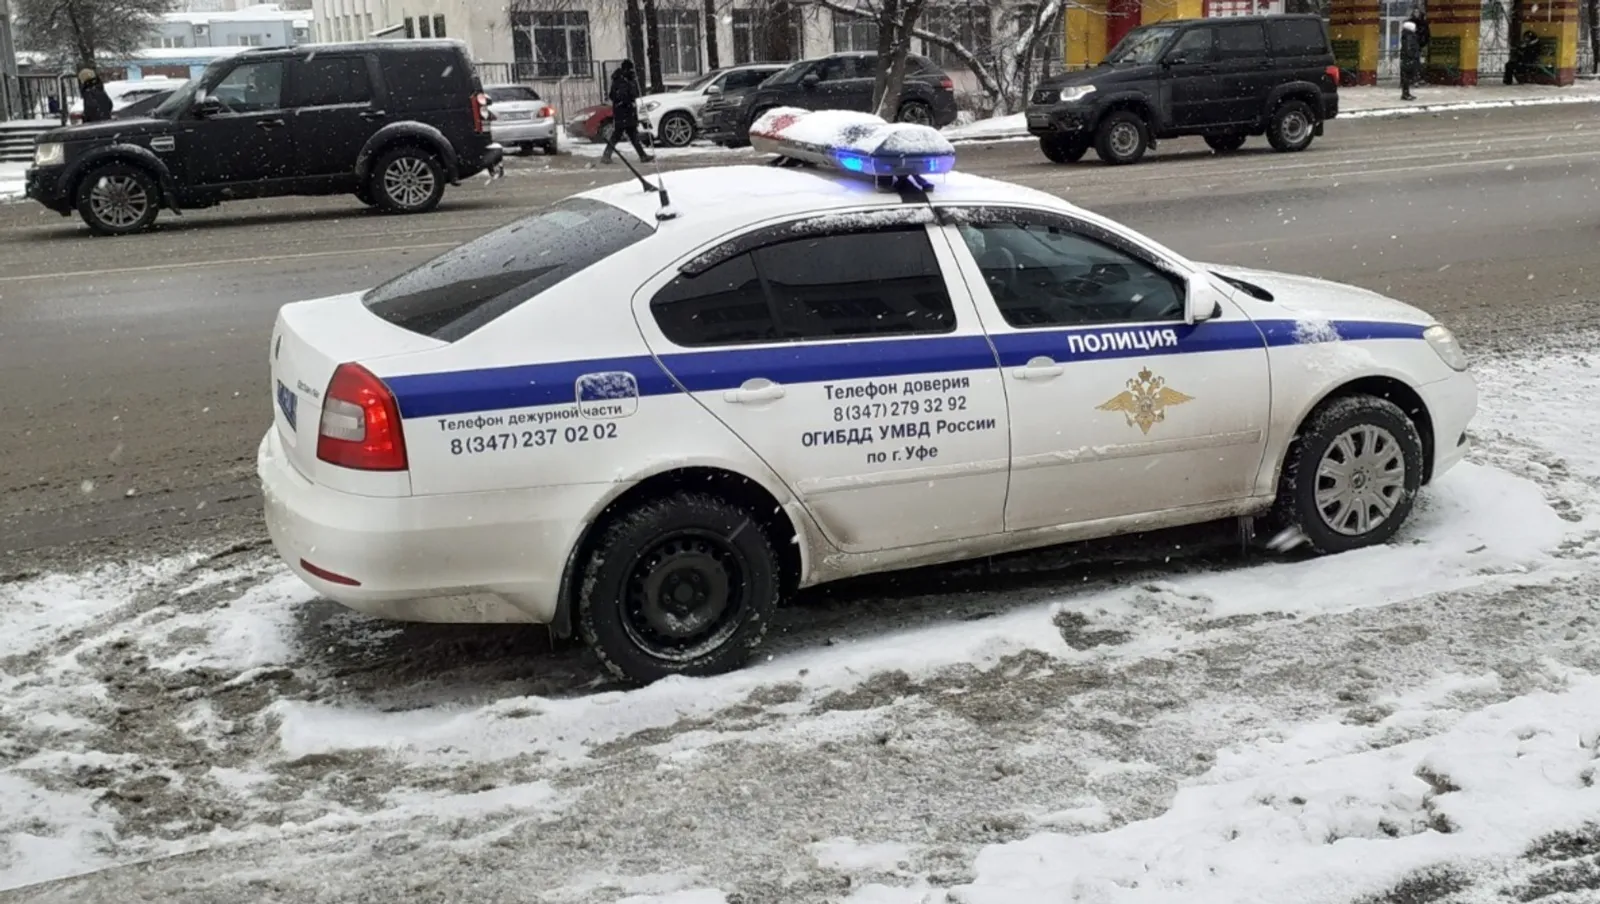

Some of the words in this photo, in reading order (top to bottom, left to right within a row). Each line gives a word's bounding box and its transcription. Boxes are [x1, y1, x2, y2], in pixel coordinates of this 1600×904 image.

[1067, 329, 1178, 353] ПОЛИЦИЯ
[824, 382, 897, 400] Телефон
[903, 377, 970, 395] доверия
[438, 415, 504, 431] Телефон
[508, 406, 579, 426] дежурной
[583, 404, 622, 417] части
[834, 404, 887, 422] 8(347)
[890, 400, 919, 416] 279
[924, 397, 943, 413] 32
[948, 395, 967, 411] 92
[450, 433, 518, 455] 8(347)
[522, 428, 557, 448] 237
[564, 425, 589, 443] 02
[593, 422, 618, 440] 02
[801, 427, 873, 447] ОГИБДД
[879, 421, 931, 440] УМВД
[936, 418, 996, 434] России
[867, 451, 887, 464] по
[892, 450, 902, 462] г.
[905, 445, 938, 461] Уфе
